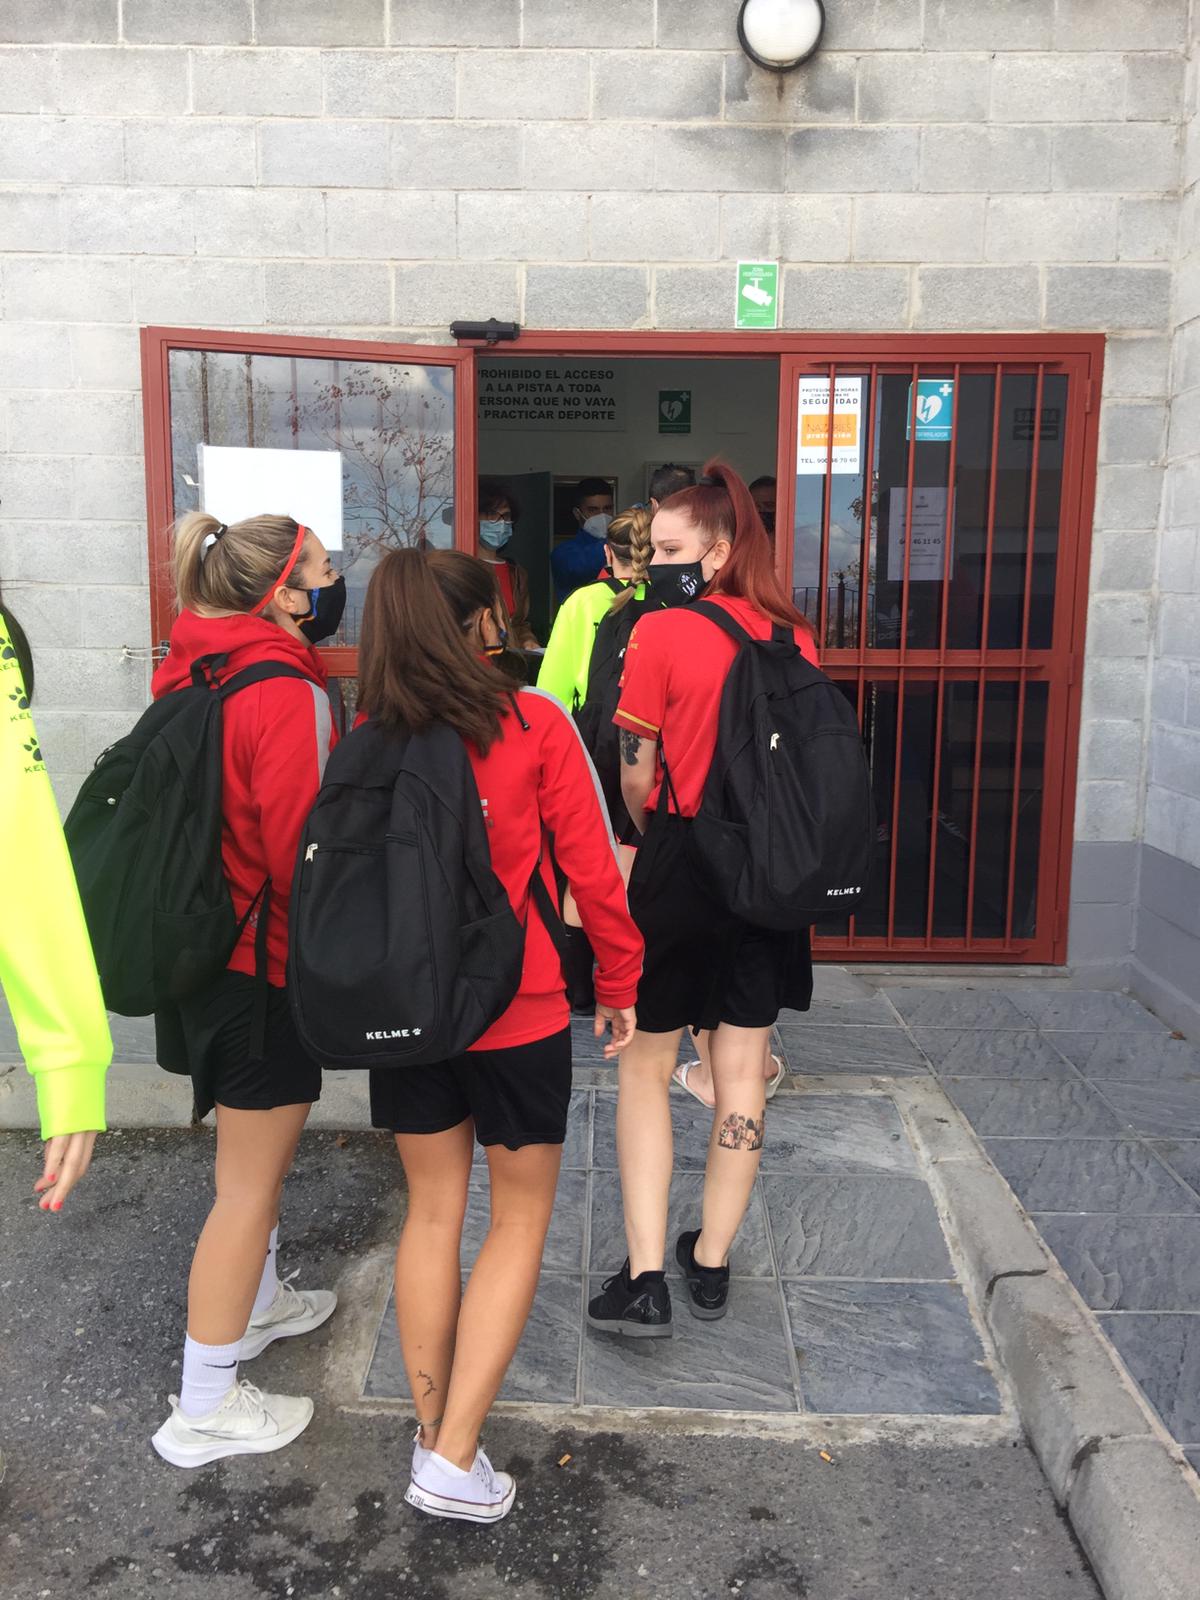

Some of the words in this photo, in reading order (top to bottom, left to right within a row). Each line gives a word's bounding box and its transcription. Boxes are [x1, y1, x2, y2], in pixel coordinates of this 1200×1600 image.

[477, 369, 542, 379] ROHIBIDO
[545, 370, 561, 379] EL
[564, 370, 615, 379] ACCESO
[485, 383, 494, 393] A
[497, 383, 514, 393] LA
[517, 383, 553, 393] PISTA
[556, 383, 565, 393] A
[568, 383, 602, 393] TODA
[479, 396, 530, 406] ERSONA
[533, 397, 560, 407] QUE
[563, 397, 581, 406] NO
[584, 397, 616, 407] VAYA
[484, 410, 555, 420] PRACTICAR
[558, 410, 616, 420] DEPORTE
[827, 887, 855, 896] KELME
[366, 1029, 410, 1040] KELME
